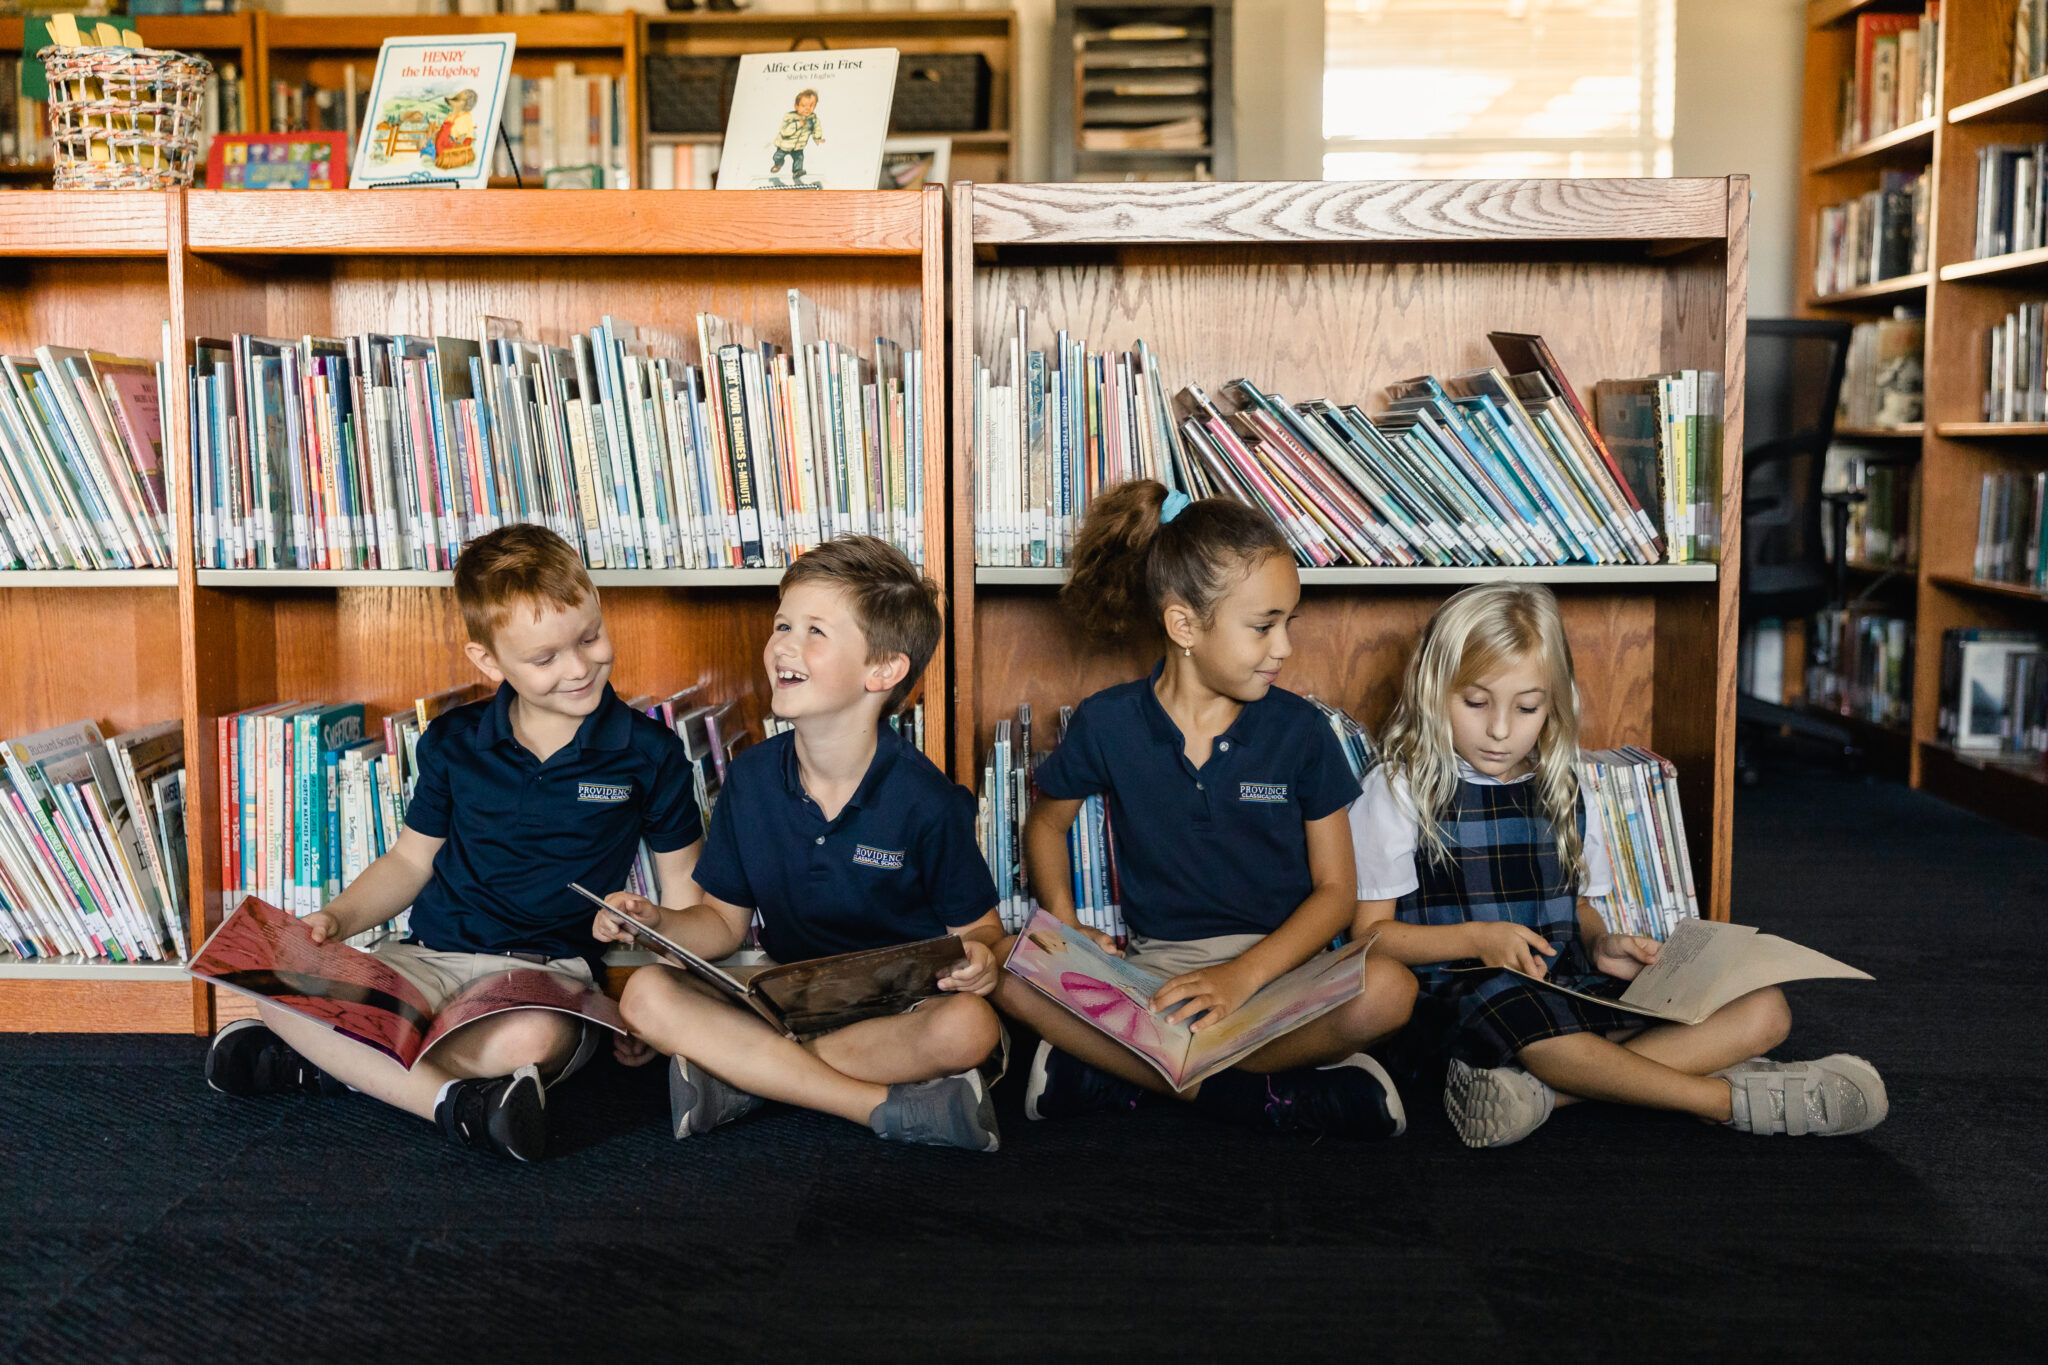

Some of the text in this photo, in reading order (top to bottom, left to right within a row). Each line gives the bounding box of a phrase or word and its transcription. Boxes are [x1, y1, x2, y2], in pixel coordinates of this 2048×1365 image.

[422, 50, 465, 63] HENRY
[763, 59, 863, 73] Alfie Gets in First
[401, 65, 480, 78] the Hedgehog
[725, 359, 738, 384] TART
[728, 386, 741, 414] YOUR
[731, 416, 747, 461] ENGINES
[736, 462, 750, 504] 5-MINUTE
[1063, 478, 1069, 490] OF
[323, 714, 361, 750] SNEETCHES
[28, 732, 83, 756] Richard Scarry's
[1242, 792, 1269, 800] CLASSICA
[34, 808, 50, 829] BEST
[57, 850, 73, 871] BOOK
[68, 869, 83, 890] EVER
[1100, 871, 1108, 886] New
[1102, 888, 1110, 906] Shell
